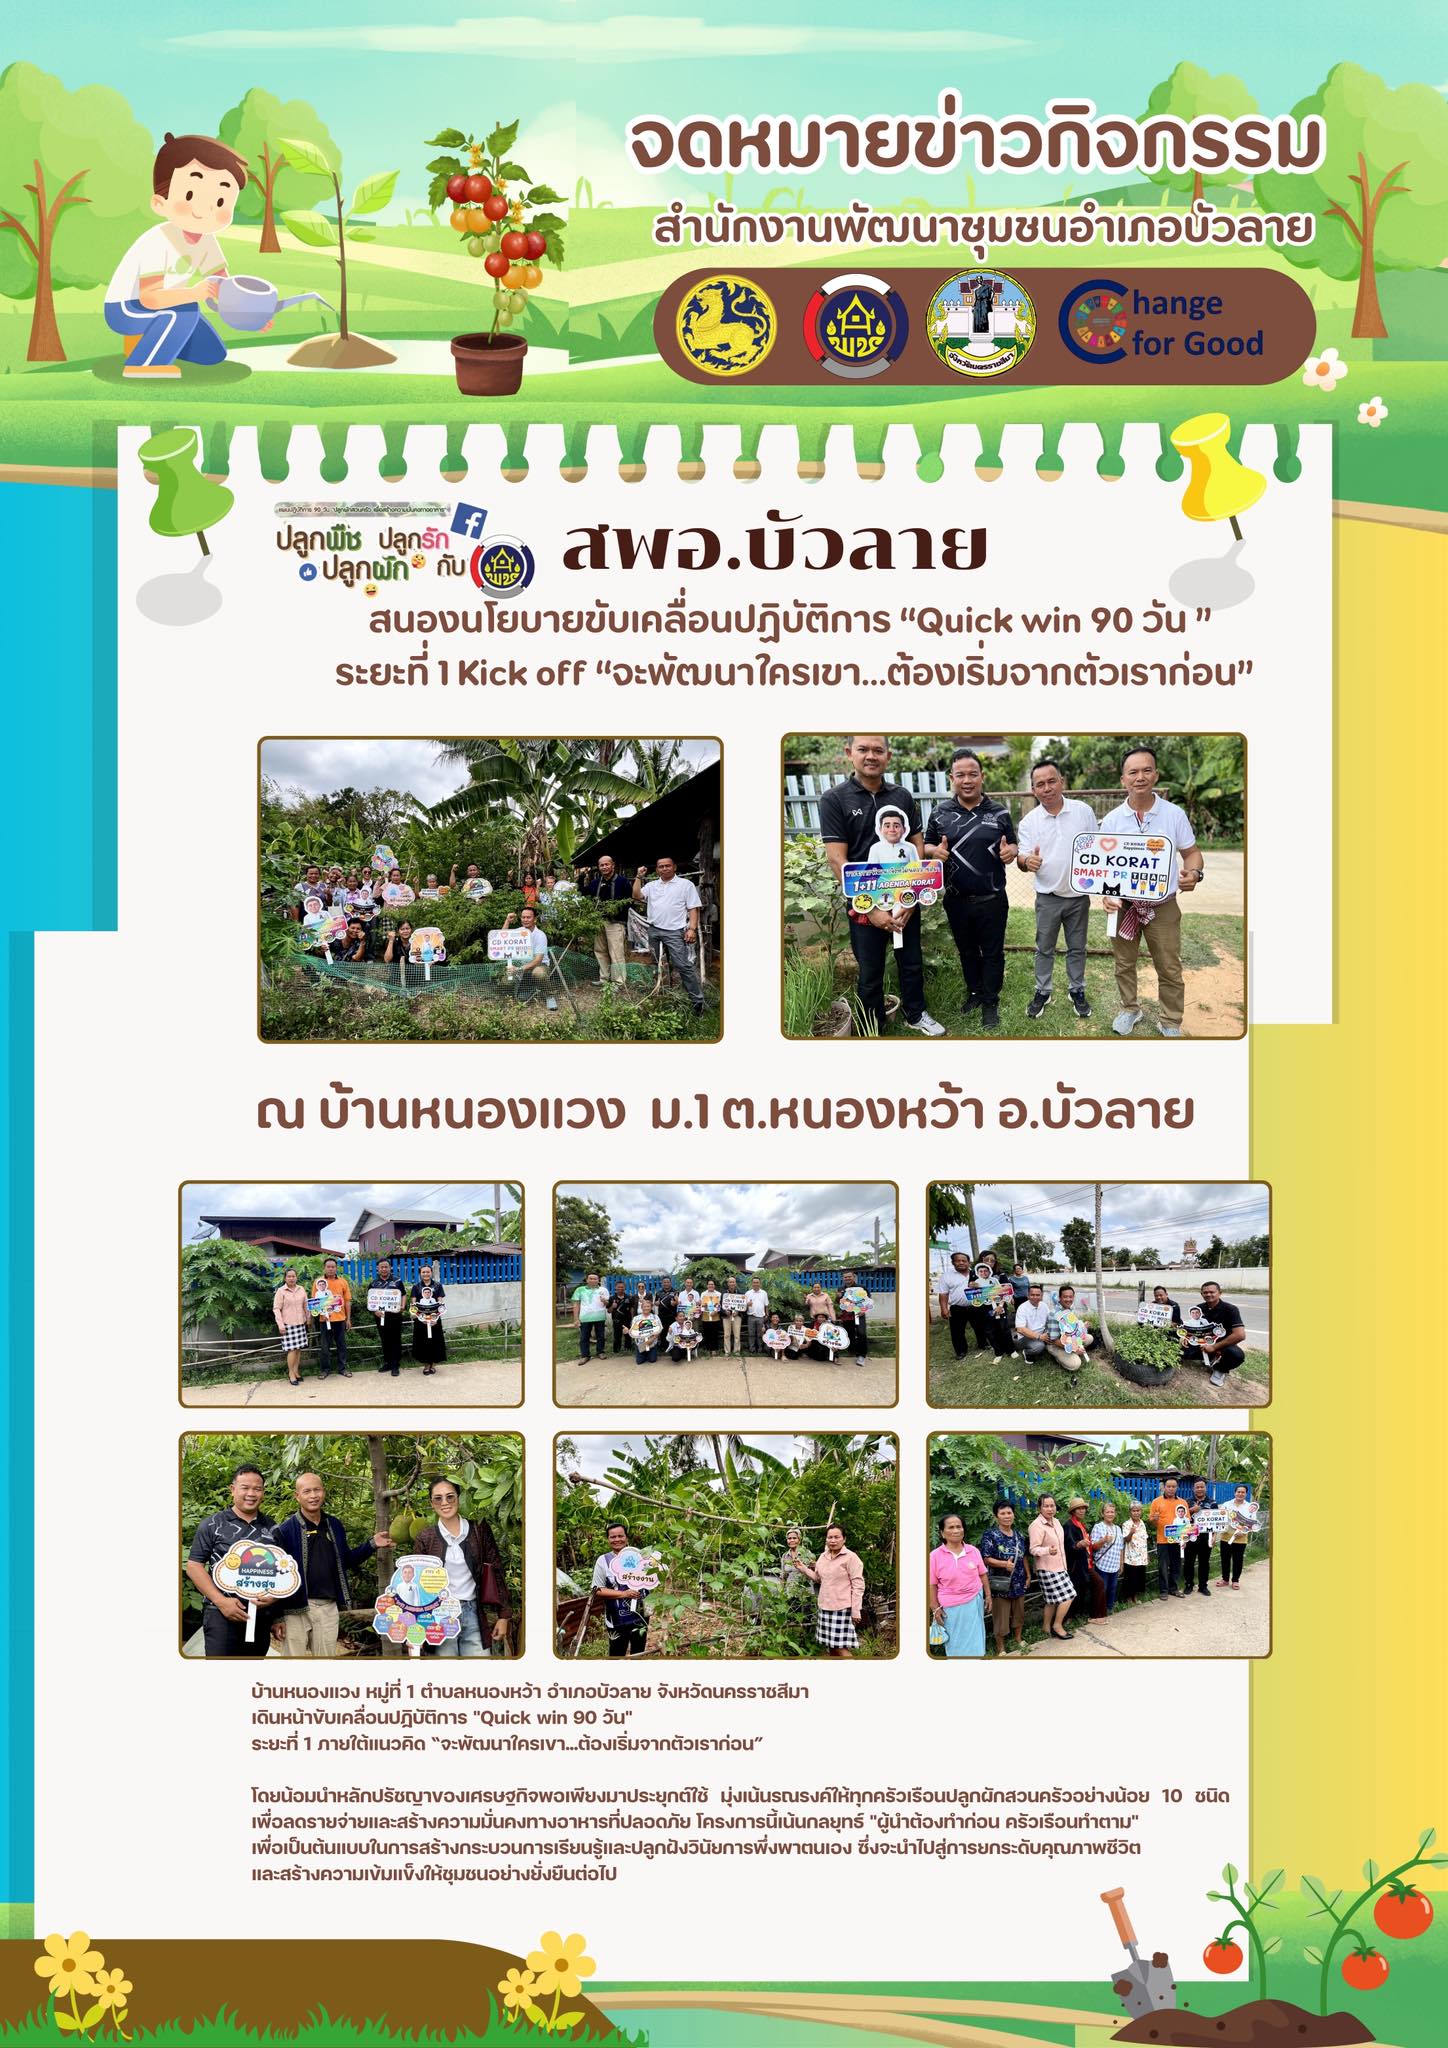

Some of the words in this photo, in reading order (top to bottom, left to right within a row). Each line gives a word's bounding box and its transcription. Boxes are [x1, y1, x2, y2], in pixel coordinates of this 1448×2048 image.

[630, 94, 1321, 168] จดหมายข่าวกิจกรรม
[654, 202, 1313, 259] สำนักงานพัฒนาชุมชนอำเภอบัวลาย
[1132, 330, 1175, 355] for
[1185, 330, 1263, 355] Good
[276, 523, 362, 558] ปลูกพืช
[379, 526, 449, 556] ปลูกรัก
[564, 510, 986, 570] สพอ.บัวลาย
[322, 555, 409, 588] ปลูกผัก
[437, 554, 466, 577] กับ
[370, 588, 890, 643] สนองนโยบายขับเคลื่อนปฏิบัติการ
[1022, 607, 1080, 633] win
[1092, 608, 1132, 633] 90
[1143, 599, 1186, 633] วัน
[337, 640, 428, 686] ระยะที่
[438, 660, 448, 686] 1
[458, 660, 528, 686] Kick
[537, 659, 588, 686] off
[1079, 853, 1100, 865] CD
[1106, 855, 1160, 870] KORAT
[853, 879, 877, 892] 1+11
[878, 880, 910, 890] AGENDA
[911, 878, 936, 888] KORAT
[1073, 867, 1110, 878] SMART
[1113, 870, 1128, 880] PR
[1131, 871, 1168, 882] TEAM
[258, 1097, 304, 1129] ณ
[321, 1082, 626, 1129] บ้านหนองแวง
[653, 1094, 709, 1129] ม.1
[723, 1082, 984, 1129] ต.หนองหว้า
[1000, 1082, 1194, 1129] อ.บัวลาย
[235, 1576, 276, 1592] สร้างสุข
[241, 1567, 275, 1576] HAPPINESS
[621, 1572, 655, 1583] สร้างงาน
[252, 1682, 360, 1699] บ้านหนองแวง
[367, 1679, 401, 1703] หมู่ที่
[407, 1685, 414, 1699] 1
[421, 1682, 541, 1699] ตำบลหนองหว้า
[548, 1682, 652, 1699] อำเภอบัวลาย
[658, 1682, 809, 1699] จังหวัดนครราชสีมา
[474, 1709, 532, 1727] "Quick
[537, 1709, 568, 1725] win
[574, 1711, 598, 1725] 90
[603, 1708, 633, 1725] วัน"
[252, 1731, 298, 1751] ระยะที่
[304, 1737, 311, 1751] 1
[318, 1734, 426, 1751] ภายใต้แนวคิด
[251, 1786, 709, 1808] โดยน้อมนำหลักปรัชญาของเศรษฐกิจพอเพียงมาประยุกต์ใช้
[721, 1786, 1150, 1808] มุ่งเน้นรณรงค์ให้ทุกครัวเรือนปลูกผักสวนครัวอย่างน้อย
[1162, 1788, 1183, 1803] 10
[1195, 1787, 1230, 1803] ชนิด
[252, 1808, 691, 1829] เพื่อลดรายจ่ายและสร้างความมั่นคงทางอาหารที่ปลอดภัย
[696, 1809, 865, 1834] โครงการนี้เน้นกลยุทธ์
[871, 1812, 1000, 1834] "ผู้นำต้องทำก่อน
[1006, 1812, 1139, 1829] ครัวเรือนทำตาม"
[252, 1834, 852, 1860] เพื่อเป็นต้นแบบในการสร้างกระบวนการเรียนรู้และปลูกฝังวินัยการพึ่งพาตนเอง
[858, 1834, 1141, 1860] ซึ่งจะนำไปสู่การยกระดับคุณภาพชีวิต
[252, 1860, 617, 1886] และสร้างความเข้มแข็งให้ชุมชนอย่างยั่งยืนต่อไป
